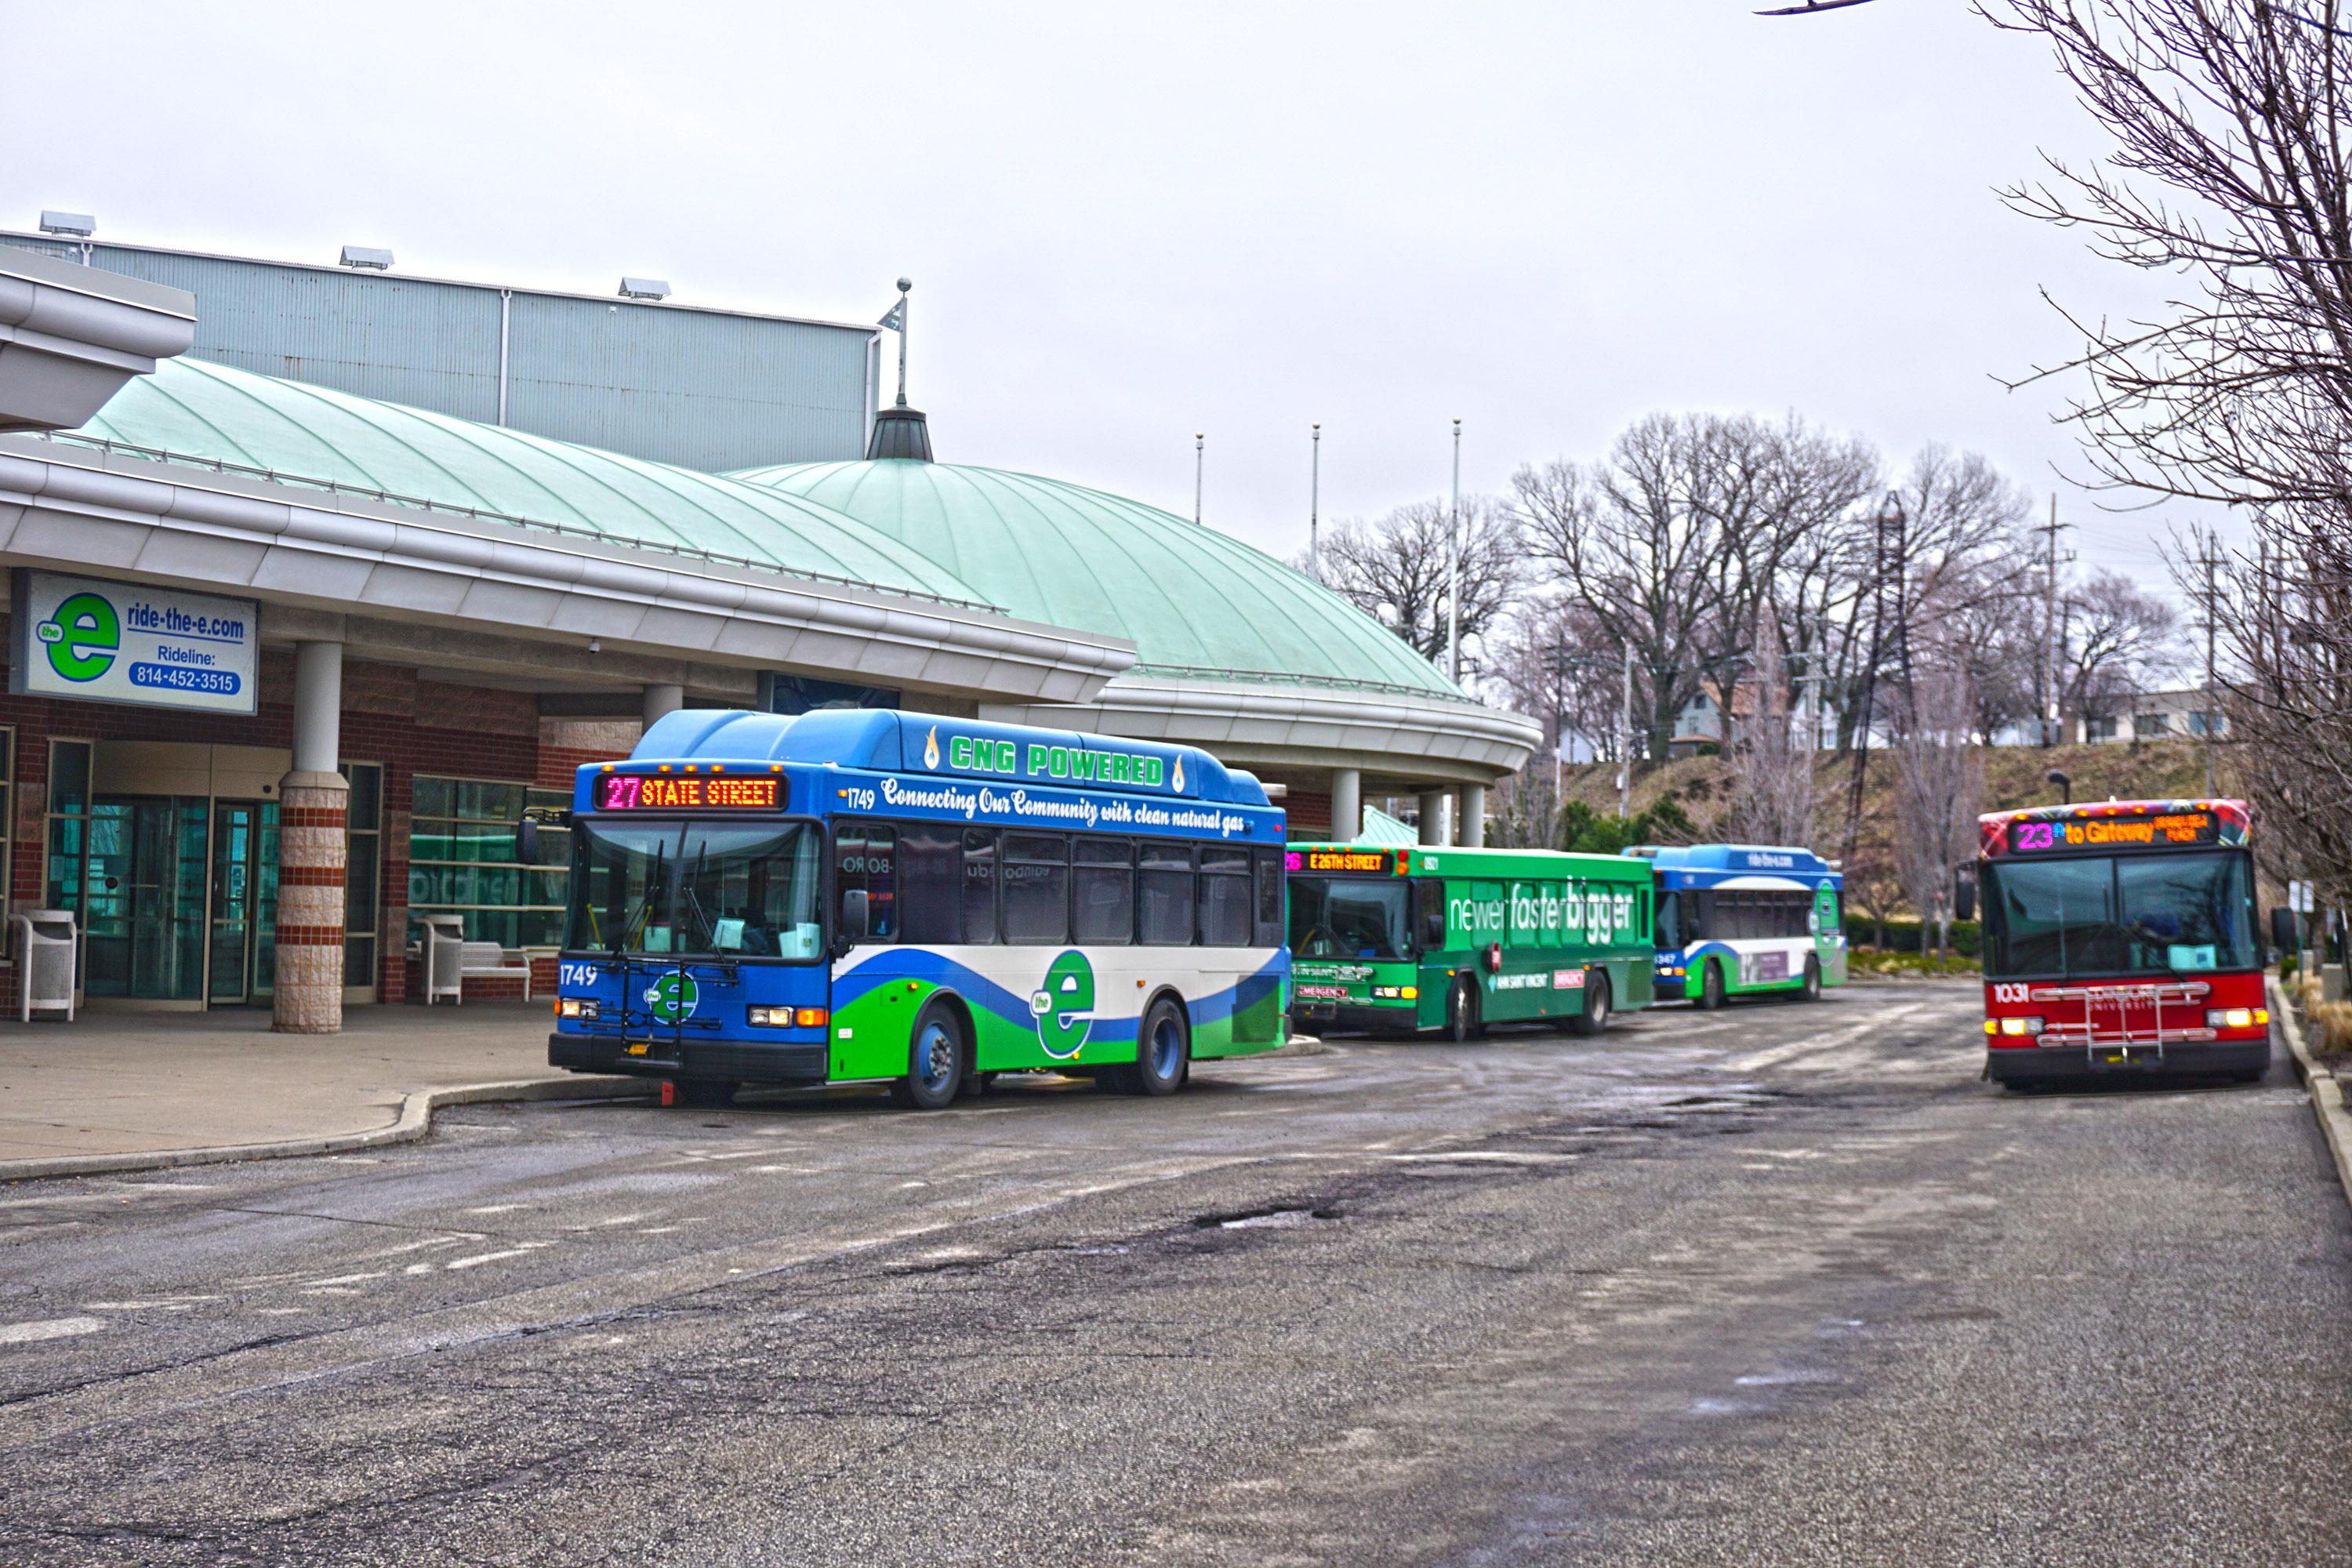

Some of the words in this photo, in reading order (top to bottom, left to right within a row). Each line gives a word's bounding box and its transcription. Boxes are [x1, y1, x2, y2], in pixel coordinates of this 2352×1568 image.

[41, 626, 60, 639] the
[127, 602, 245, 640] ride-the-e.com
[46, 593, 120, 682] e
[158, 645, 216, 666] Rideline:
[137, 666, 234, 692] 814-452-3515
[949, 735, 1015, 774] CNG
[1027, 744, 1163, 786] POWERED
[605, 776, 641, 809] 27
[641, 780, 702, 806] STATE
[706, 780, 778, 805] STREET
[847, 787, 876, 811] 1749
[880, 778, 977, 819] Connecting
[978, 787, 1011, 814] Our
[1011, 789, 1098, 828] Community
[1101, 800, 1132, 823] with
[1134, 803, 1170, 826] clean
[1171, 809, 1220, 829] natural
[1221, 815, 1246, 837] gas
[2065, 823, 2085, 844] to
[2085, 821, 2154, 844] Gateway
[1310, 854, 1318, 869] E
[1344, 855, 1383, 871] STREET
[1450, 898, 1509, 931] newer
[1510, 883, 1566, 930] faster
[1566, 875, 1635, 945] bigger
[560, 964, 597, 987] 1749
[1034, 993, 1048, 1009] the
[1037, 949, 1094, 1059] e
[1994, 983, 2030, 1004] 1031
